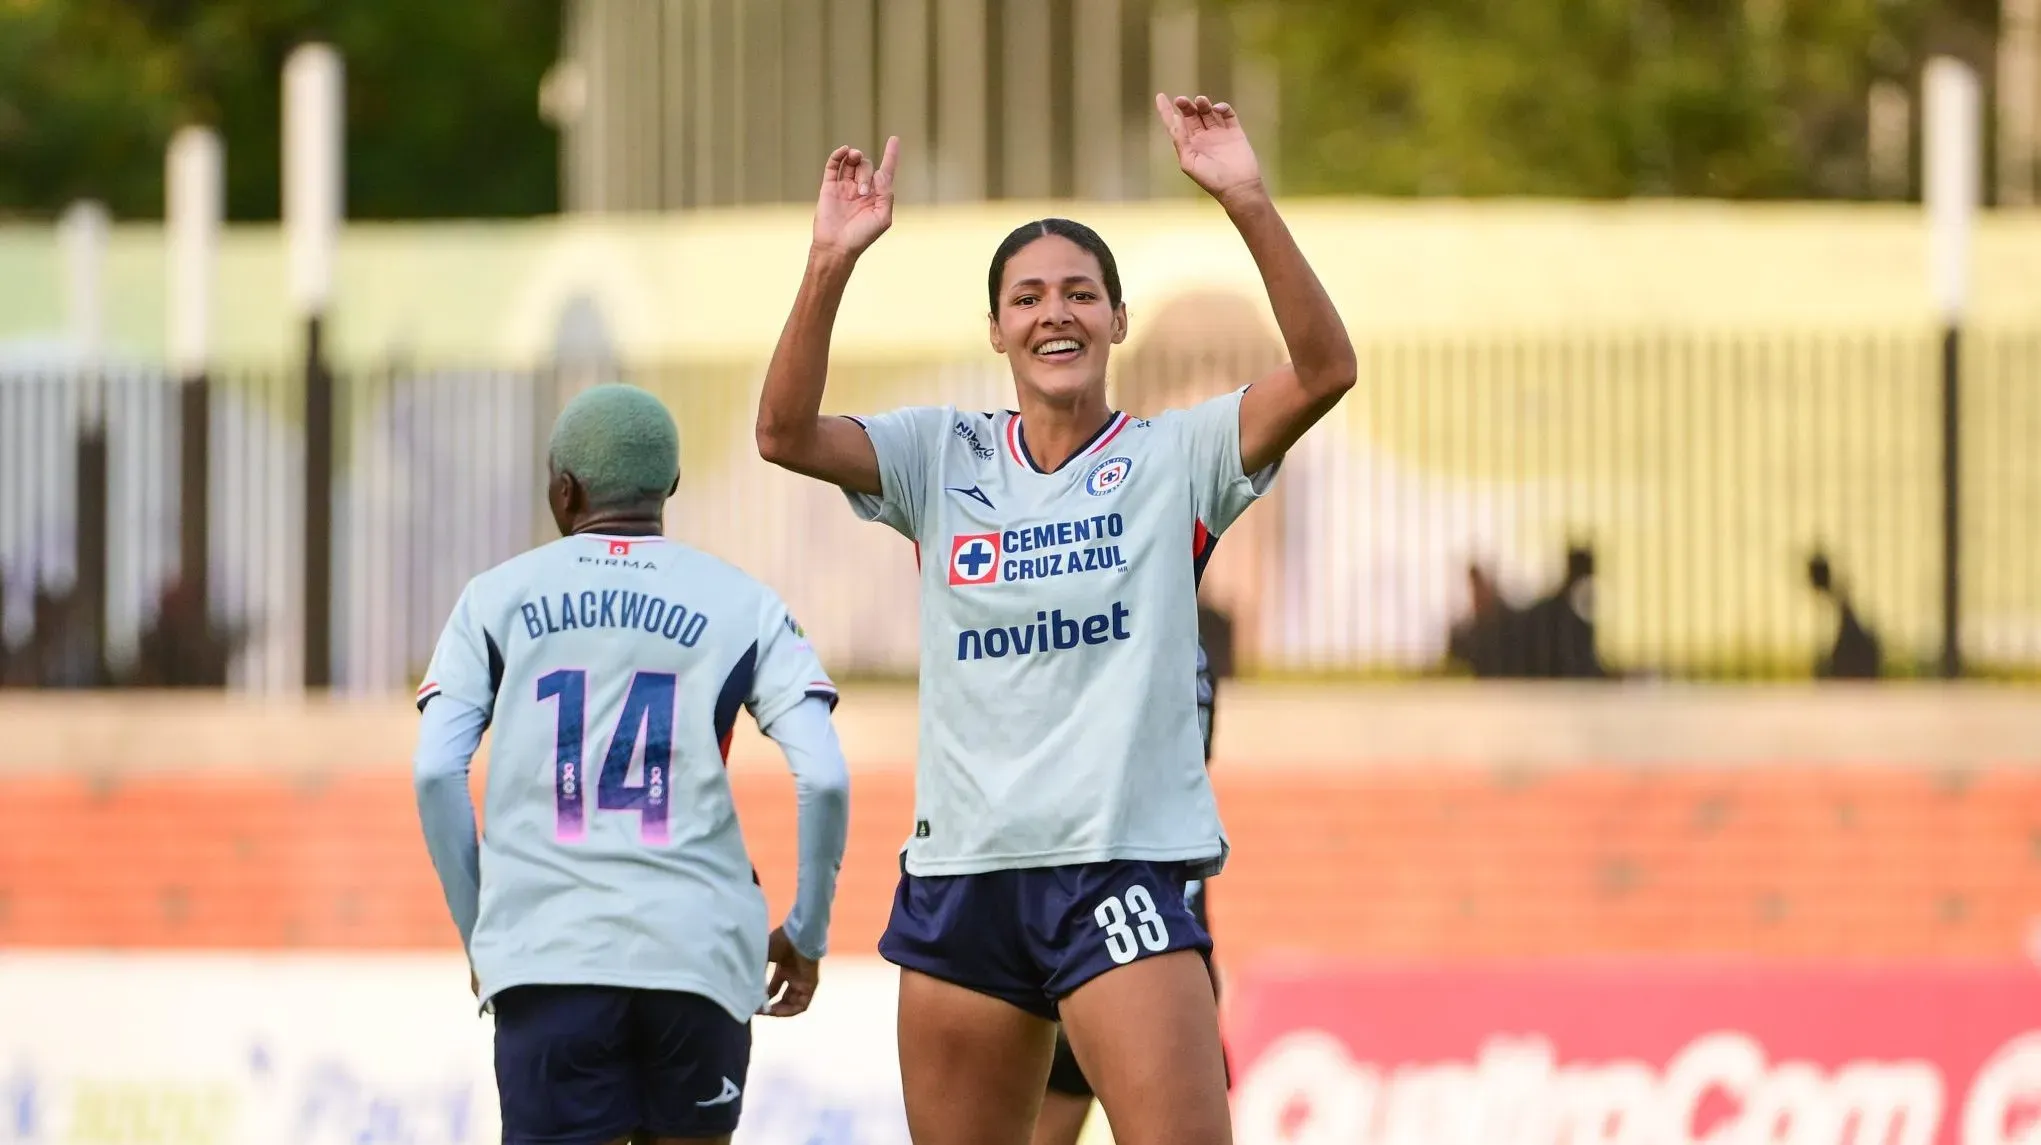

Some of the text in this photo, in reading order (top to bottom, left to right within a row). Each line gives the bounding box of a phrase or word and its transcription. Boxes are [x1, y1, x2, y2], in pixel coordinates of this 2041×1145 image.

[1002, 512, 1124, 553] CEMENTO
[1003, 545, 1127, 582] CRUZ AZUL
[521, 589, 708, 648] BLACKWOOD
[957, 601, 1131, 661] novibet
[536, 668, 678, 845] 14
[1094, 884, 1169, 964] 33
